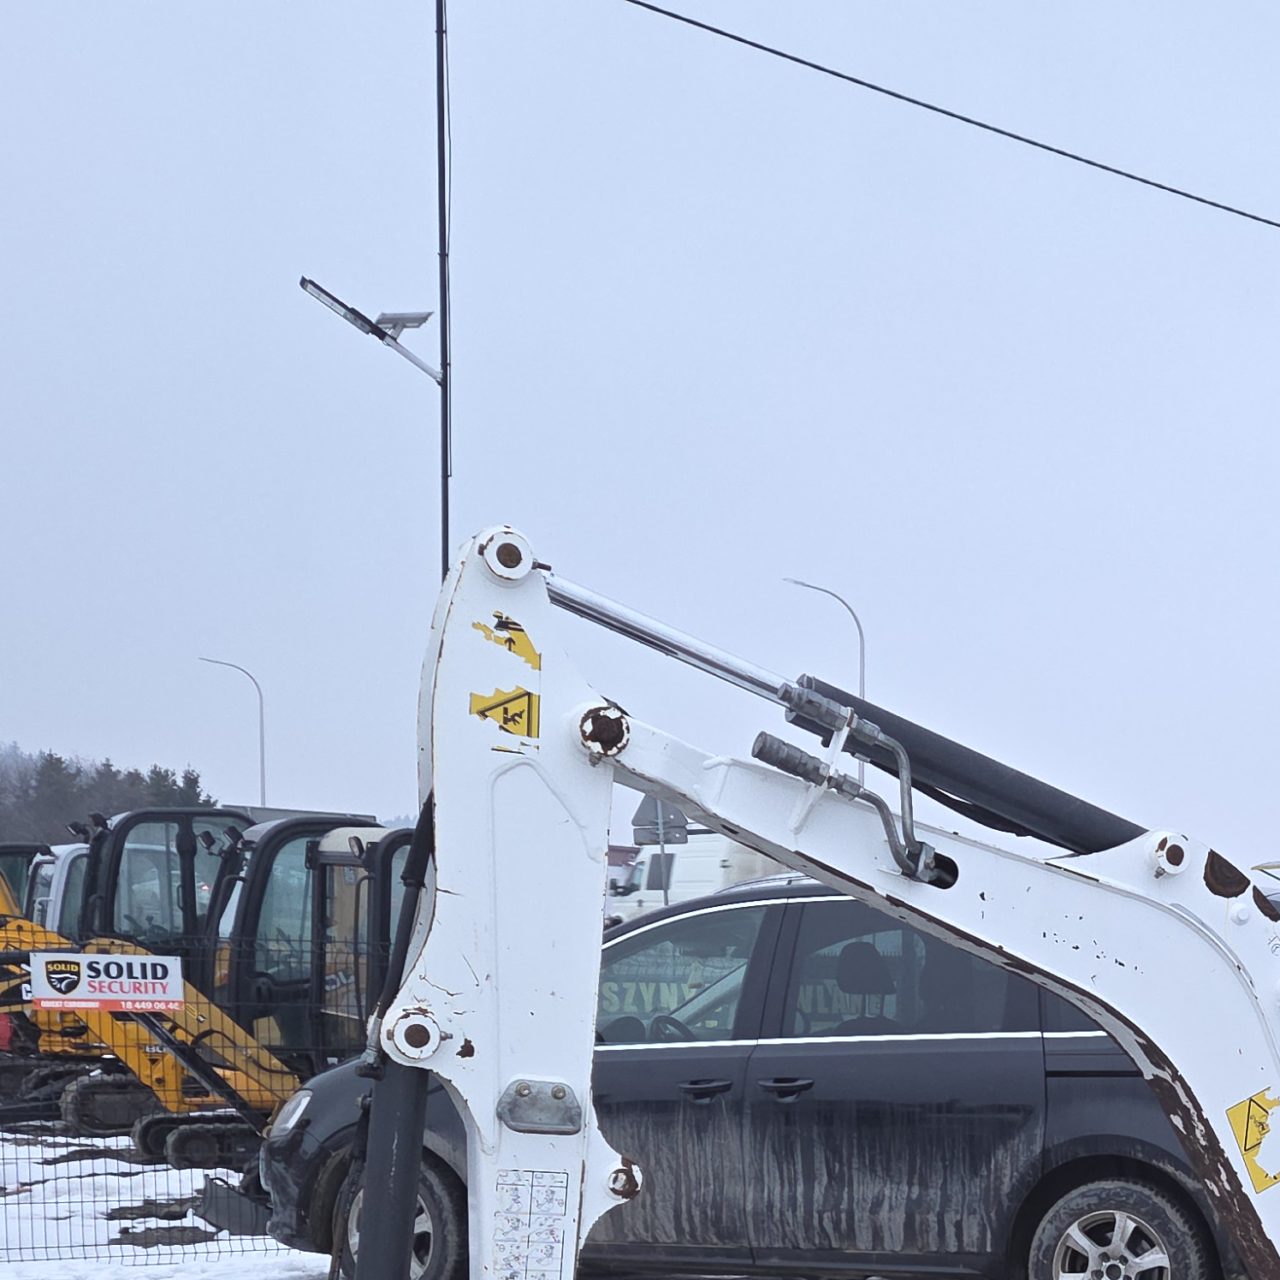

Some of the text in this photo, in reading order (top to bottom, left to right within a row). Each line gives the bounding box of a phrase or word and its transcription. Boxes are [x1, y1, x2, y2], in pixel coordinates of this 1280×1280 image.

[47, 963, 79, 972] SOLID
[86, 961, 169, 981] SOLID
[87, 981, 169, 994] SECURITY
[120, 1001, 133, 1009] 18
[134, 1001, 152, 1010] 449
